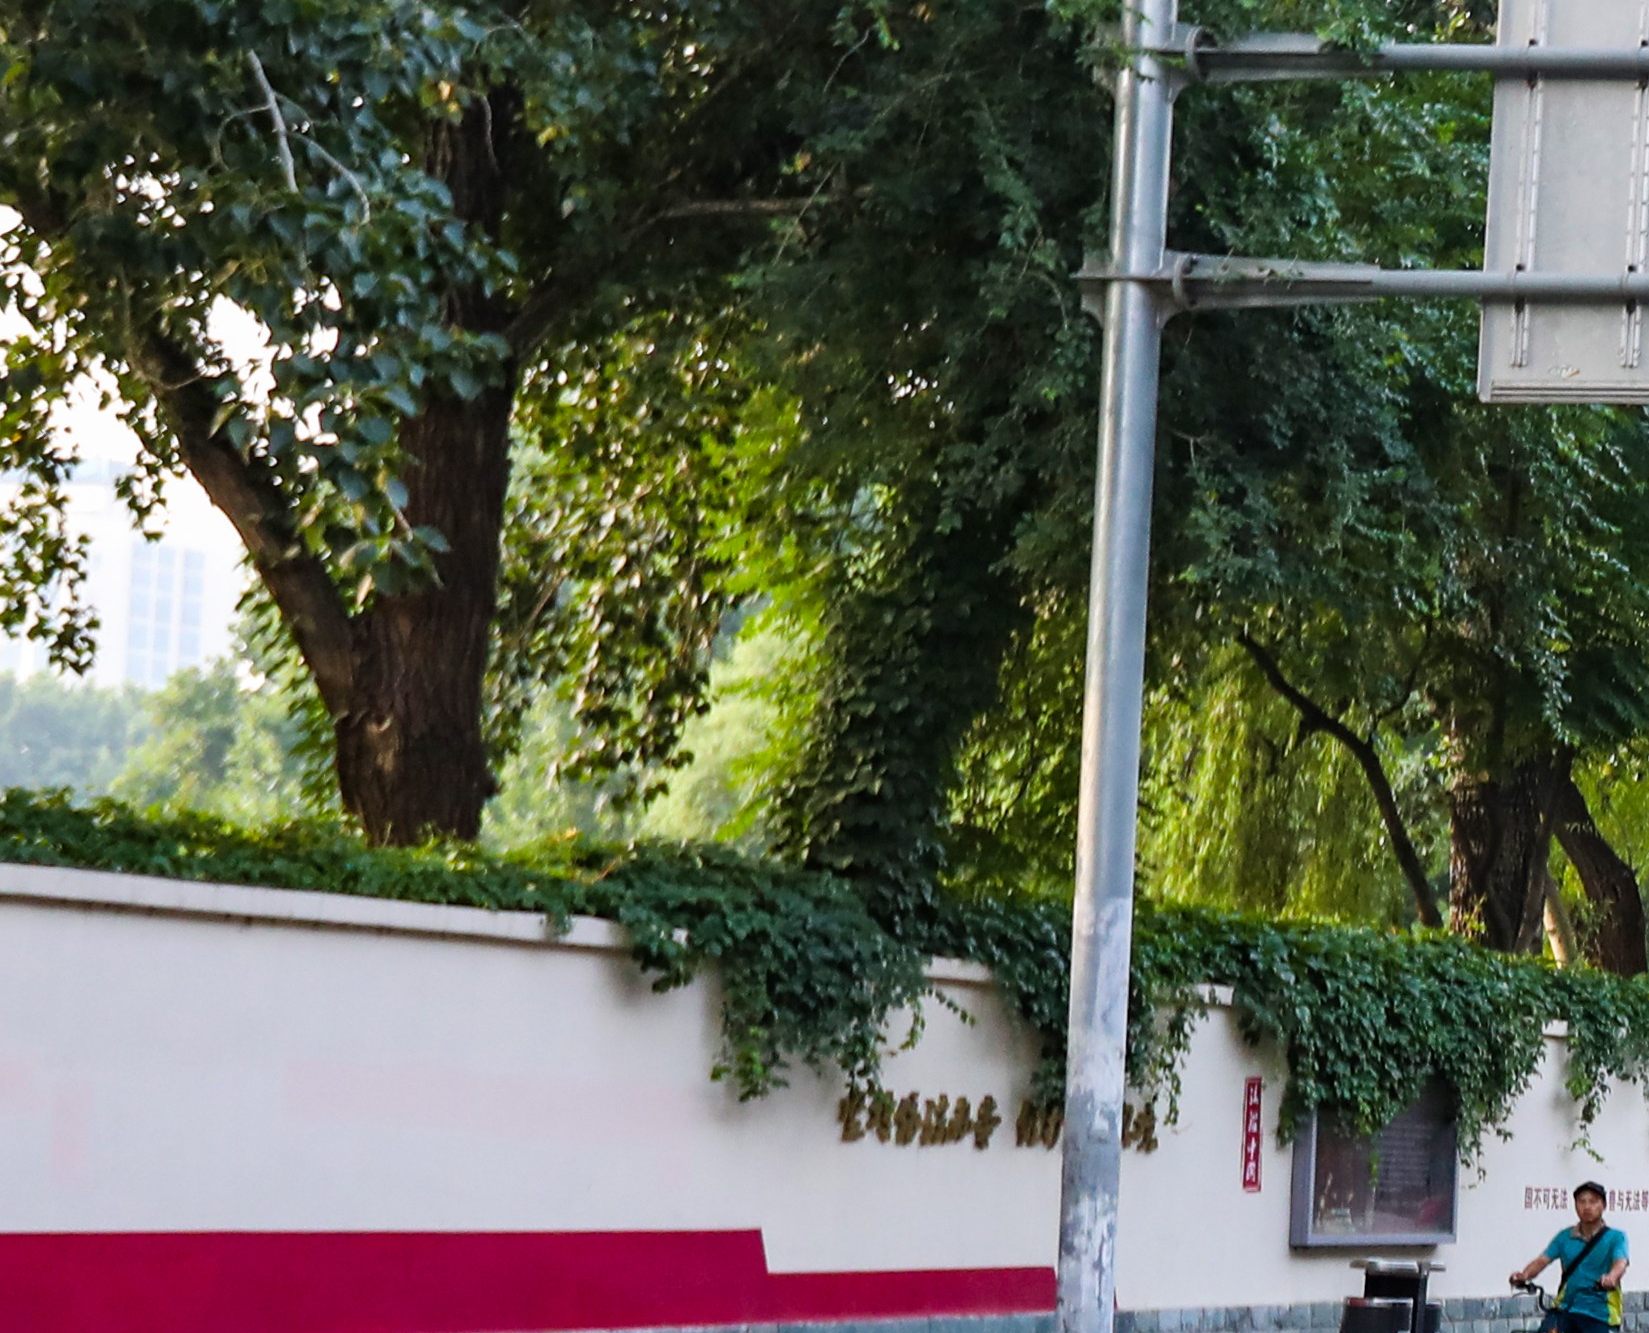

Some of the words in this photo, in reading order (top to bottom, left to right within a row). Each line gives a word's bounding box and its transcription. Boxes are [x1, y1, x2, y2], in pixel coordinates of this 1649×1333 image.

[1524, 1187, 1568, 1210] 国不可无法
